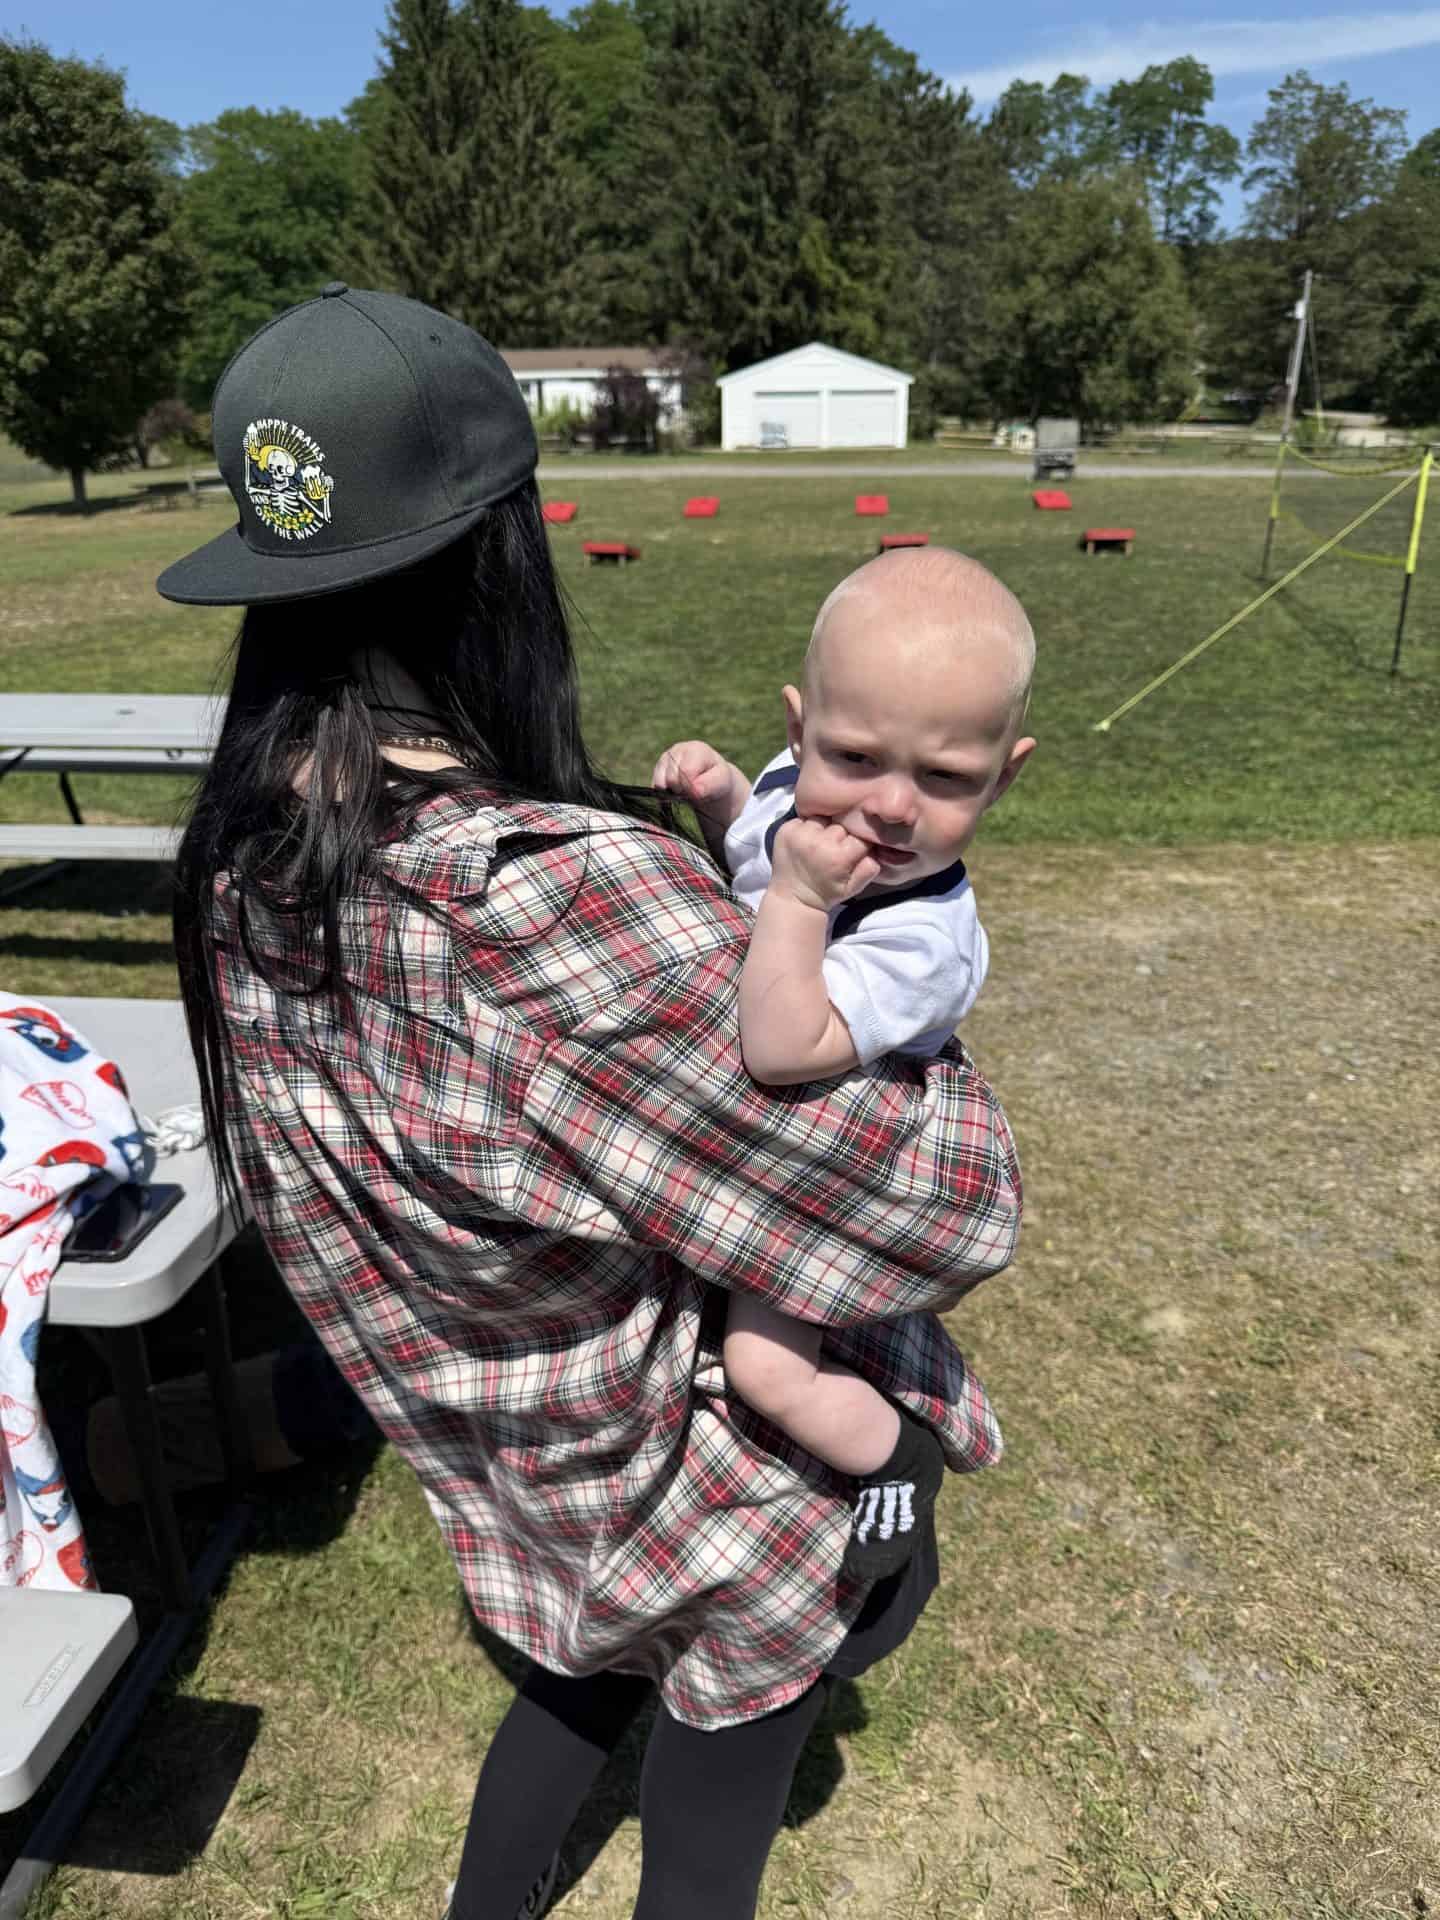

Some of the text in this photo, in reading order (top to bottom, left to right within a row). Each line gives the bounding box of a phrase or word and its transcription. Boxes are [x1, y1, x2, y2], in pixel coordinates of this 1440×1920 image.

[256, 419, 325, 462] HAPPY TRAILS
[273, 519, 323, 540] THE WALL
